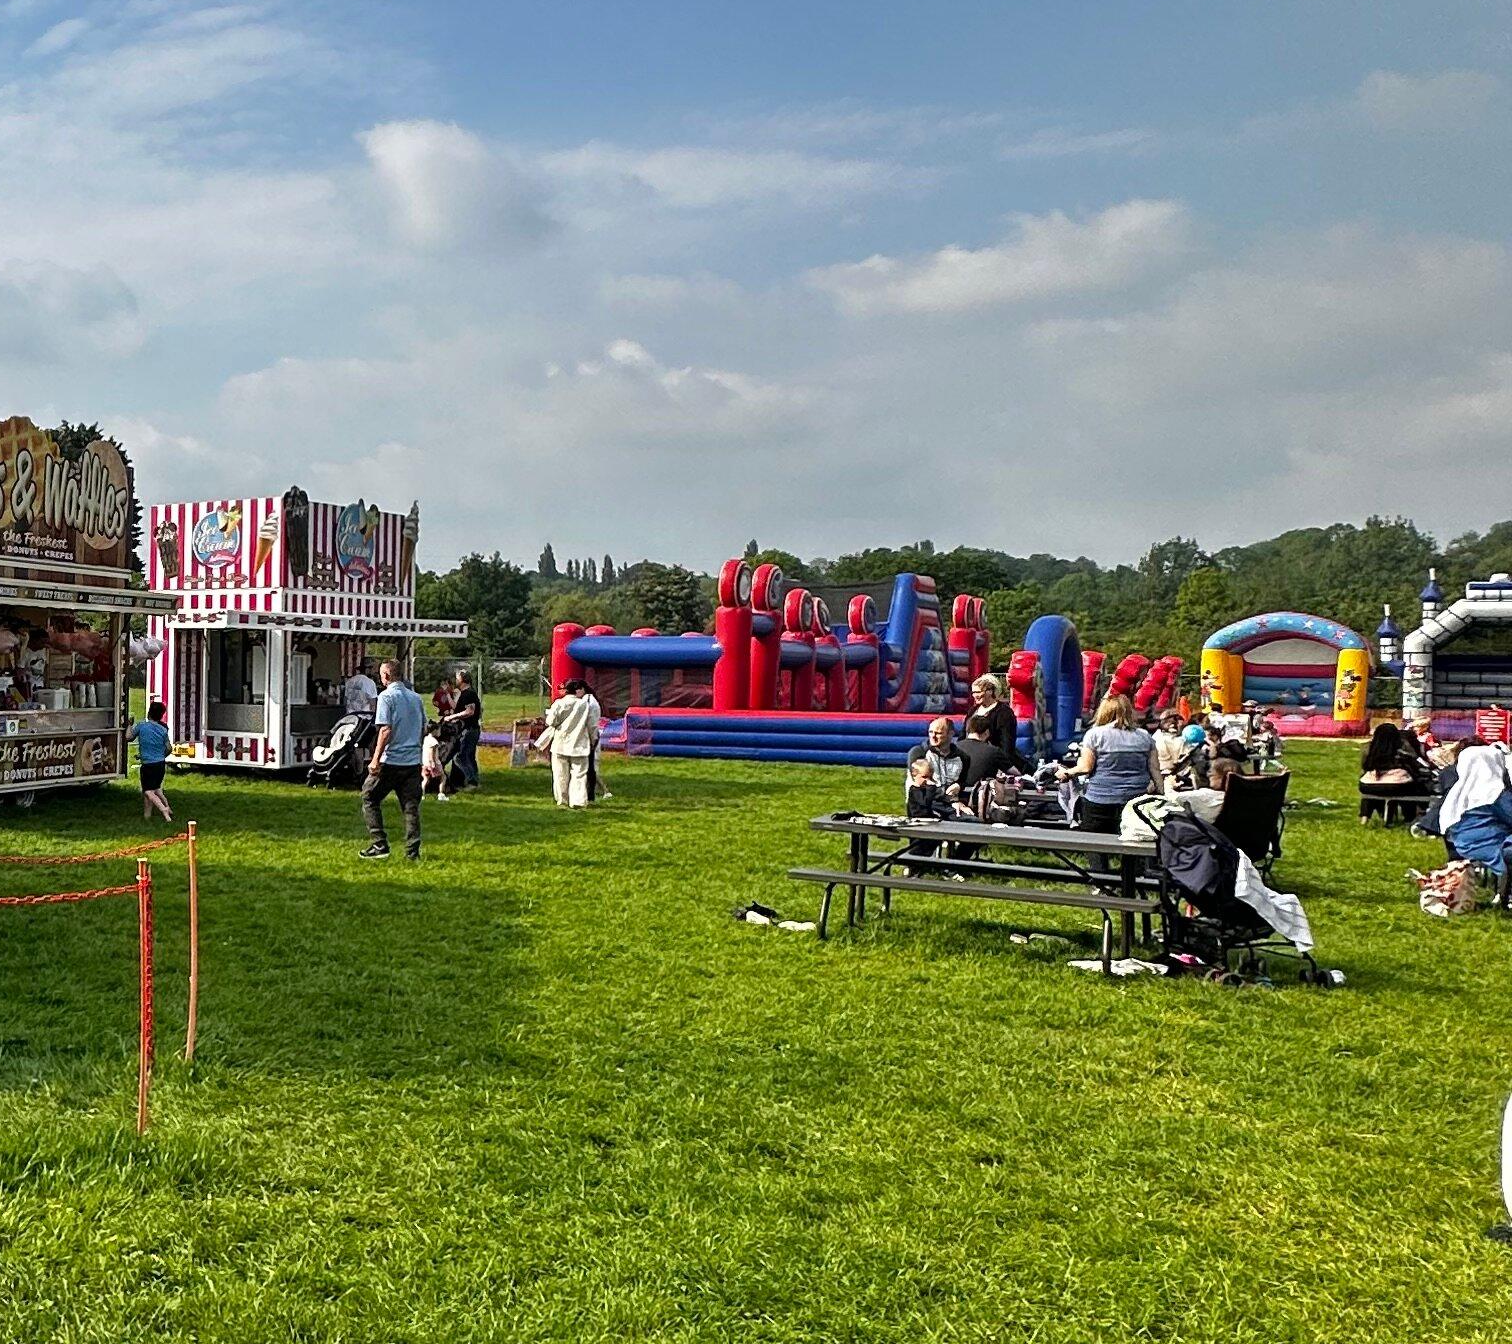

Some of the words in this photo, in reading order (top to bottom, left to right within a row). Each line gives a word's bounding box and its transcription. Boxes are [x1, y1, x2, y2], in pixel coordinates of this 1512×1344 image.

[11, 448, 36, 526] &
[44, 450, 128, 540] Waffles
[3, 529, 22, 544] the
[24, 532, 68, 549] Freshest
[7, 545, 39, 556] DONUTS
[44, 550, 74, 560] CREPES
[23, 741, 77, 761] Freshest
[4, 768, 37, 781] DONUTS
[43, 764, 74, 777] CREPES
